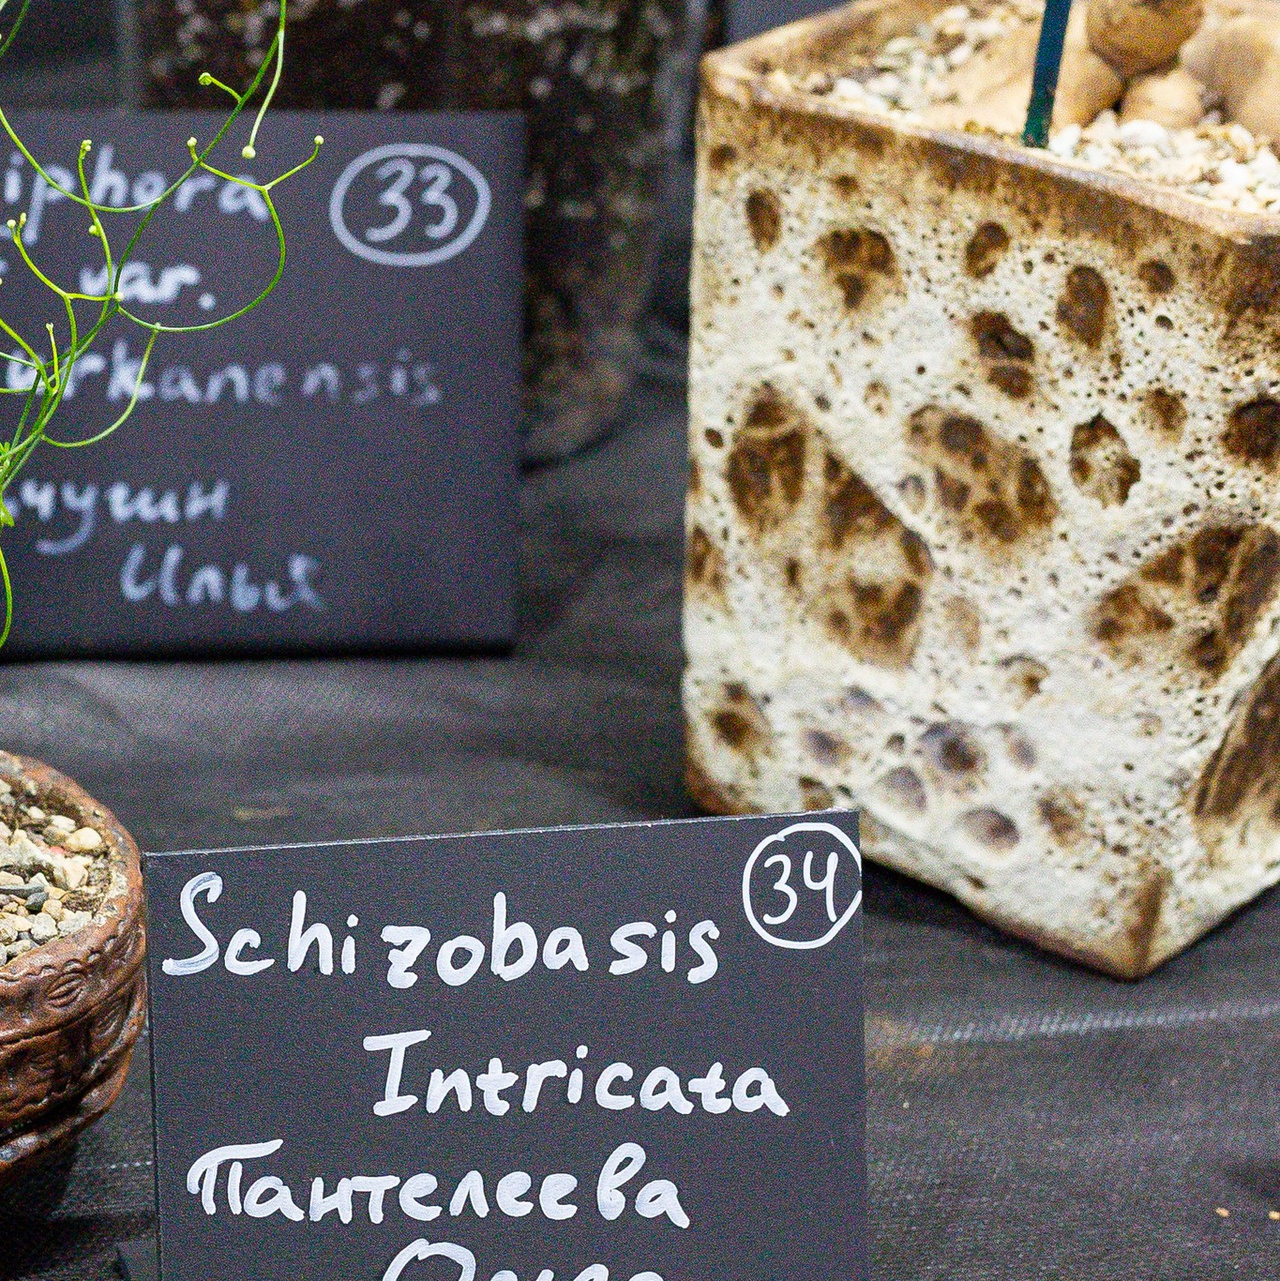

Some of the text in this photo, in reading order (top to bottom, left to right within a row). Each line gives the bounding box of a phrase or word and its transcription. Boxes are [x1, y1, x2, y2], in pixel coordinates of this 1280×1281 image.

[366, 159, 461, 243] 33
[79, 259, 215, 310] var.
[162, 872, 721, 988] Schizobasis
[763, 851, 839, 926] 34
[363, 1030, 790, 1118] Intricata
[185, 1139, 690, 1228] Пантелеева
